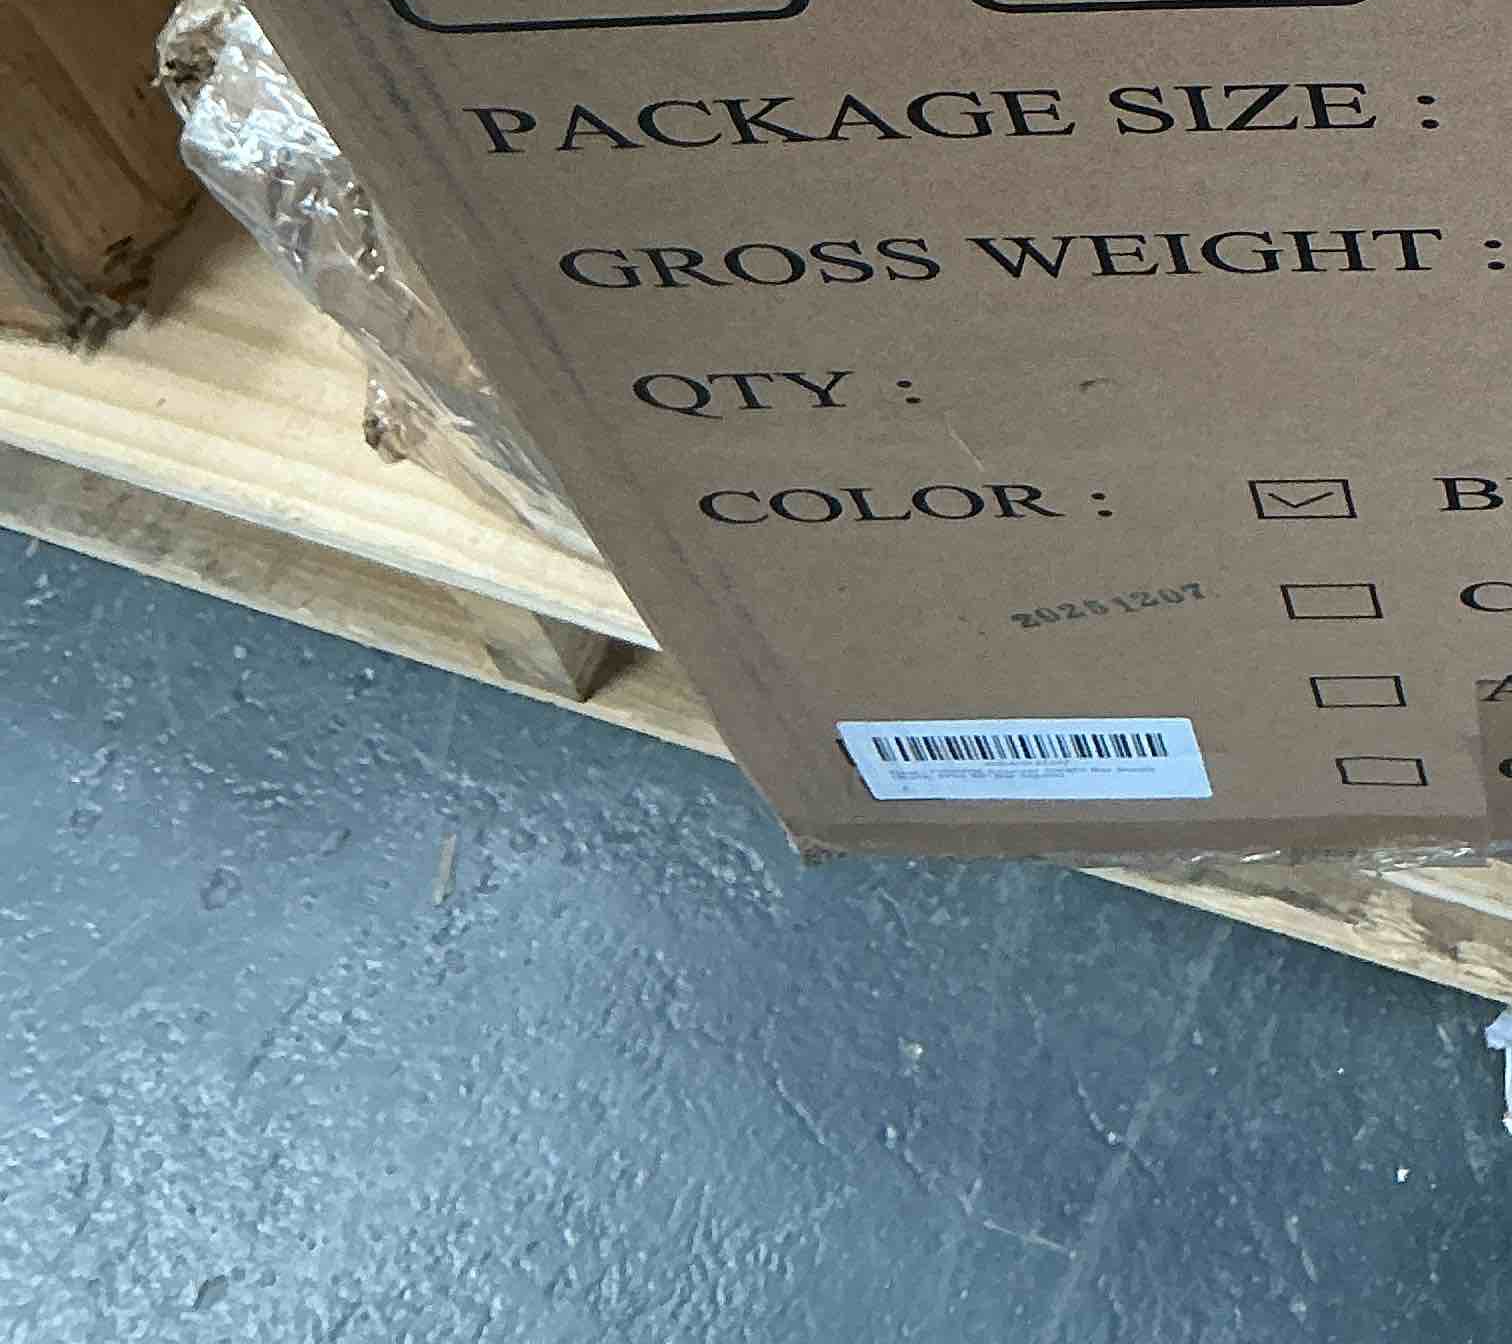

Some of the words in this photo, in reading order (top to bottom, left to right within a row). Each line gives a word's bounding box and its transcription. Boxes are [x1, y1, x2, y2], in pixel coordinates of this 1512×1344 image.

[465, 88, 1076, 155] PACKAGE
[558, 236, 942, 290] GROSS
[967, 226, 1444, 280] WEIGHT
[632, 369, 855, 420] QTY
[698, 484, 1066, 525] COLOR
